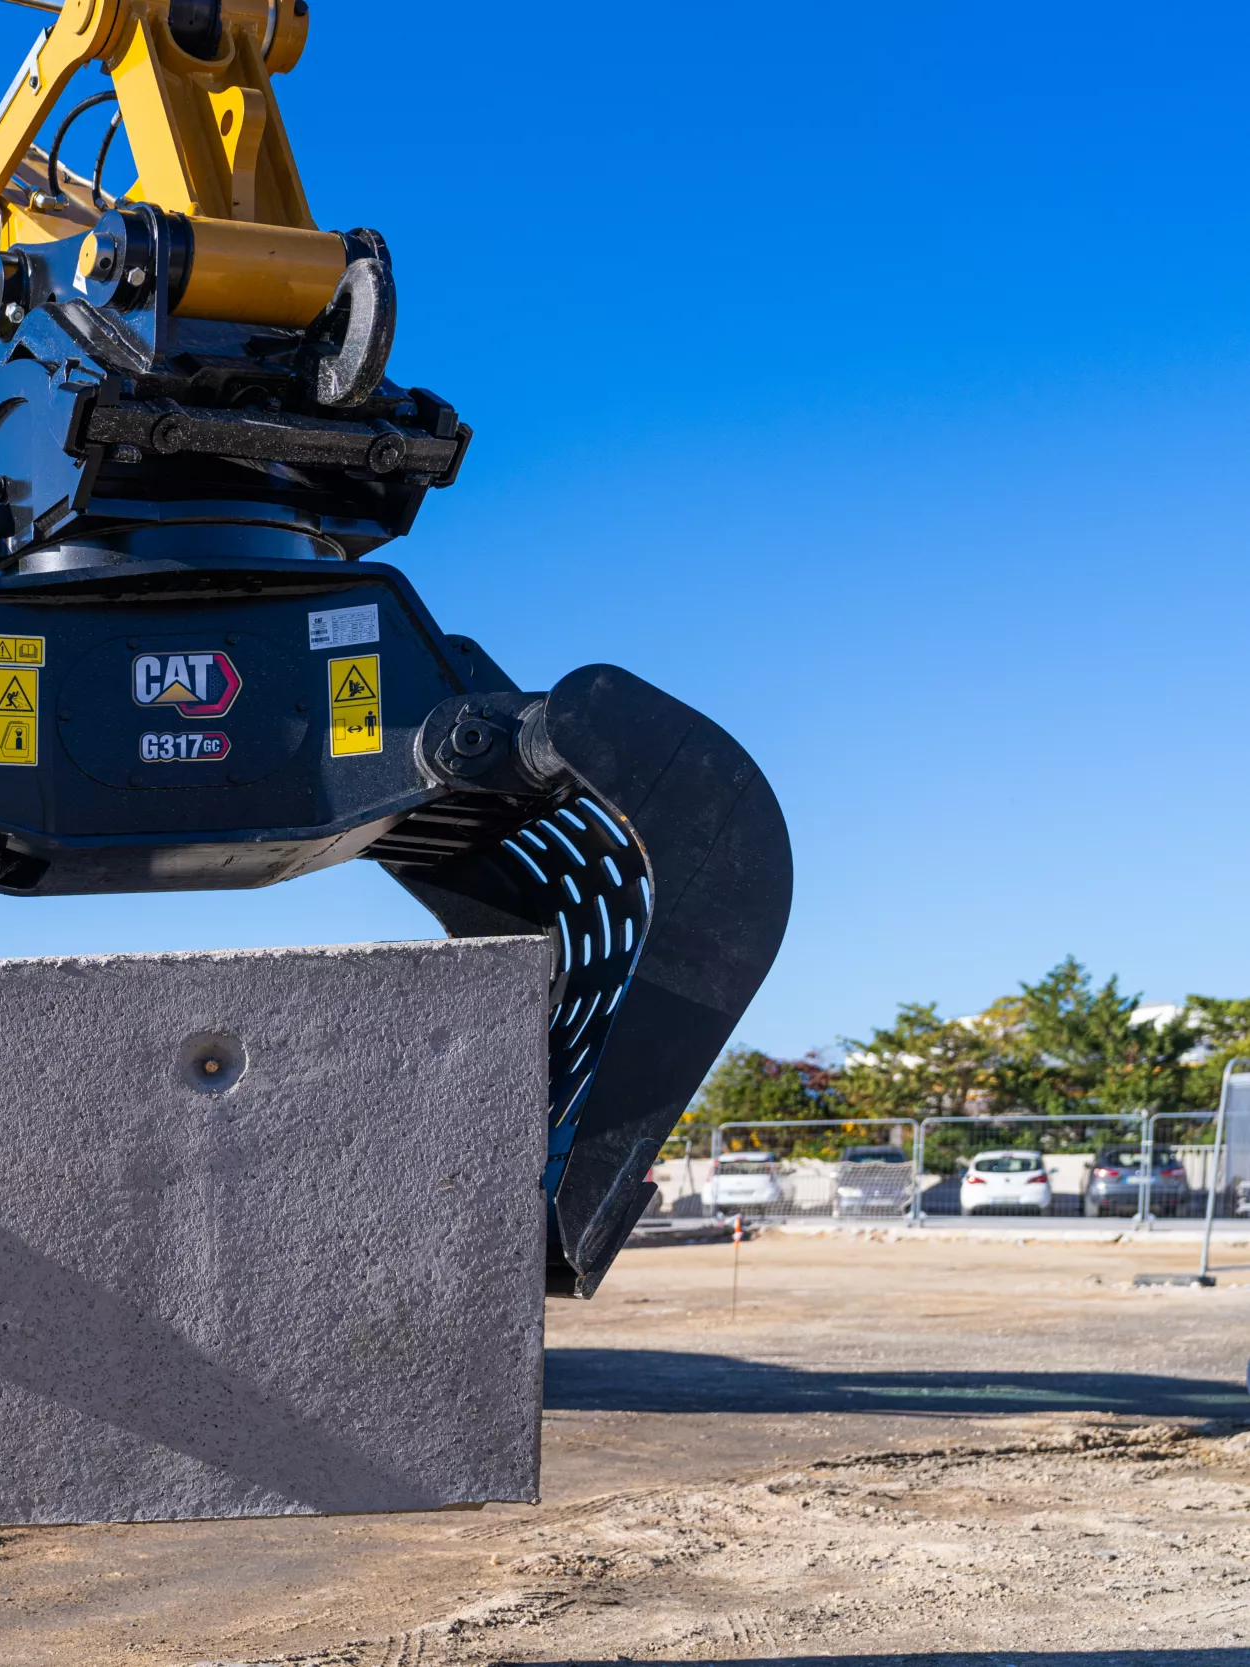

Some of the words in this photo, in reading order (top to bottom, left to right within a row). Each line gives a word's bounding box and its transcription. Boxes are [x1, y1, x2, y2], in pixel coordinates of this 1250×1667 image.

[135, 654, 214, 704] CAT
[142, 734, 203, 760] G317
[203, 739, 220, 752] GC
